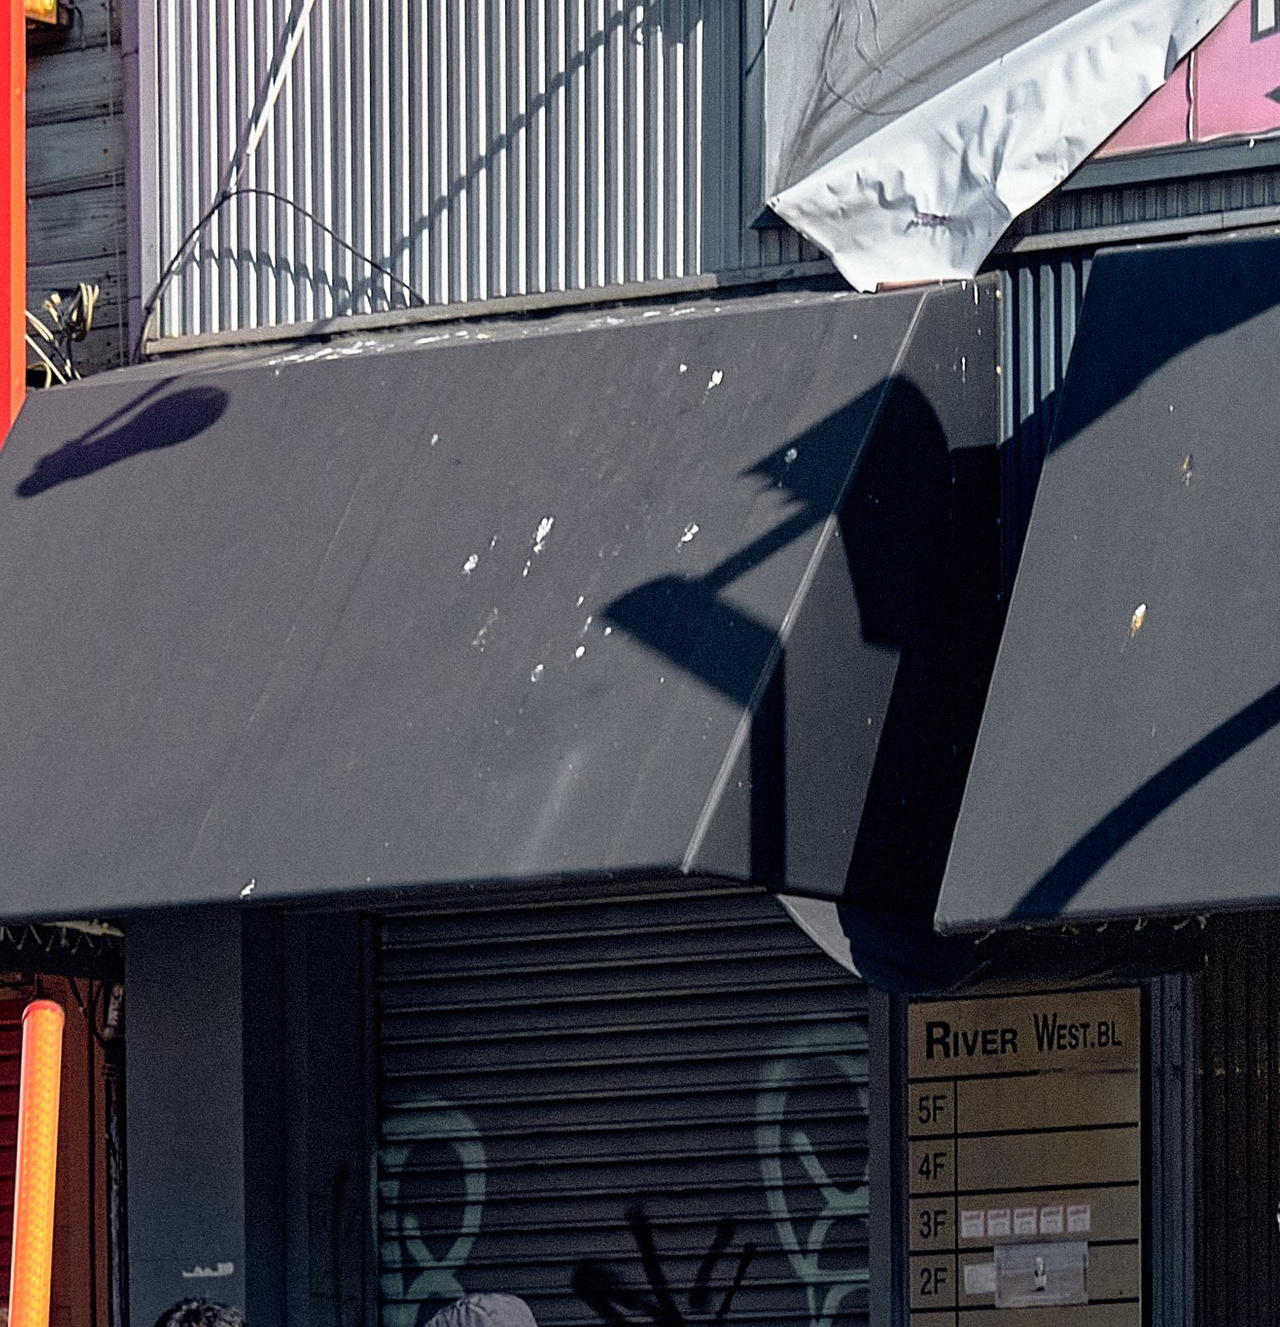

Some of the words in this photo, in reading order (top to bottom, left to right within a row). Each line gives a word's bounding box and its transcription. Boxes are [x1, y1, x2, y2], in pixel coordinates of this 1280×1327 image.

[918, 1095, 948, 1124] 5F
[917, 1152, 947, 1181] 4F
[919, 1209, 947, 1239] 3F
[919, 1267, 948, 1295] 2F
